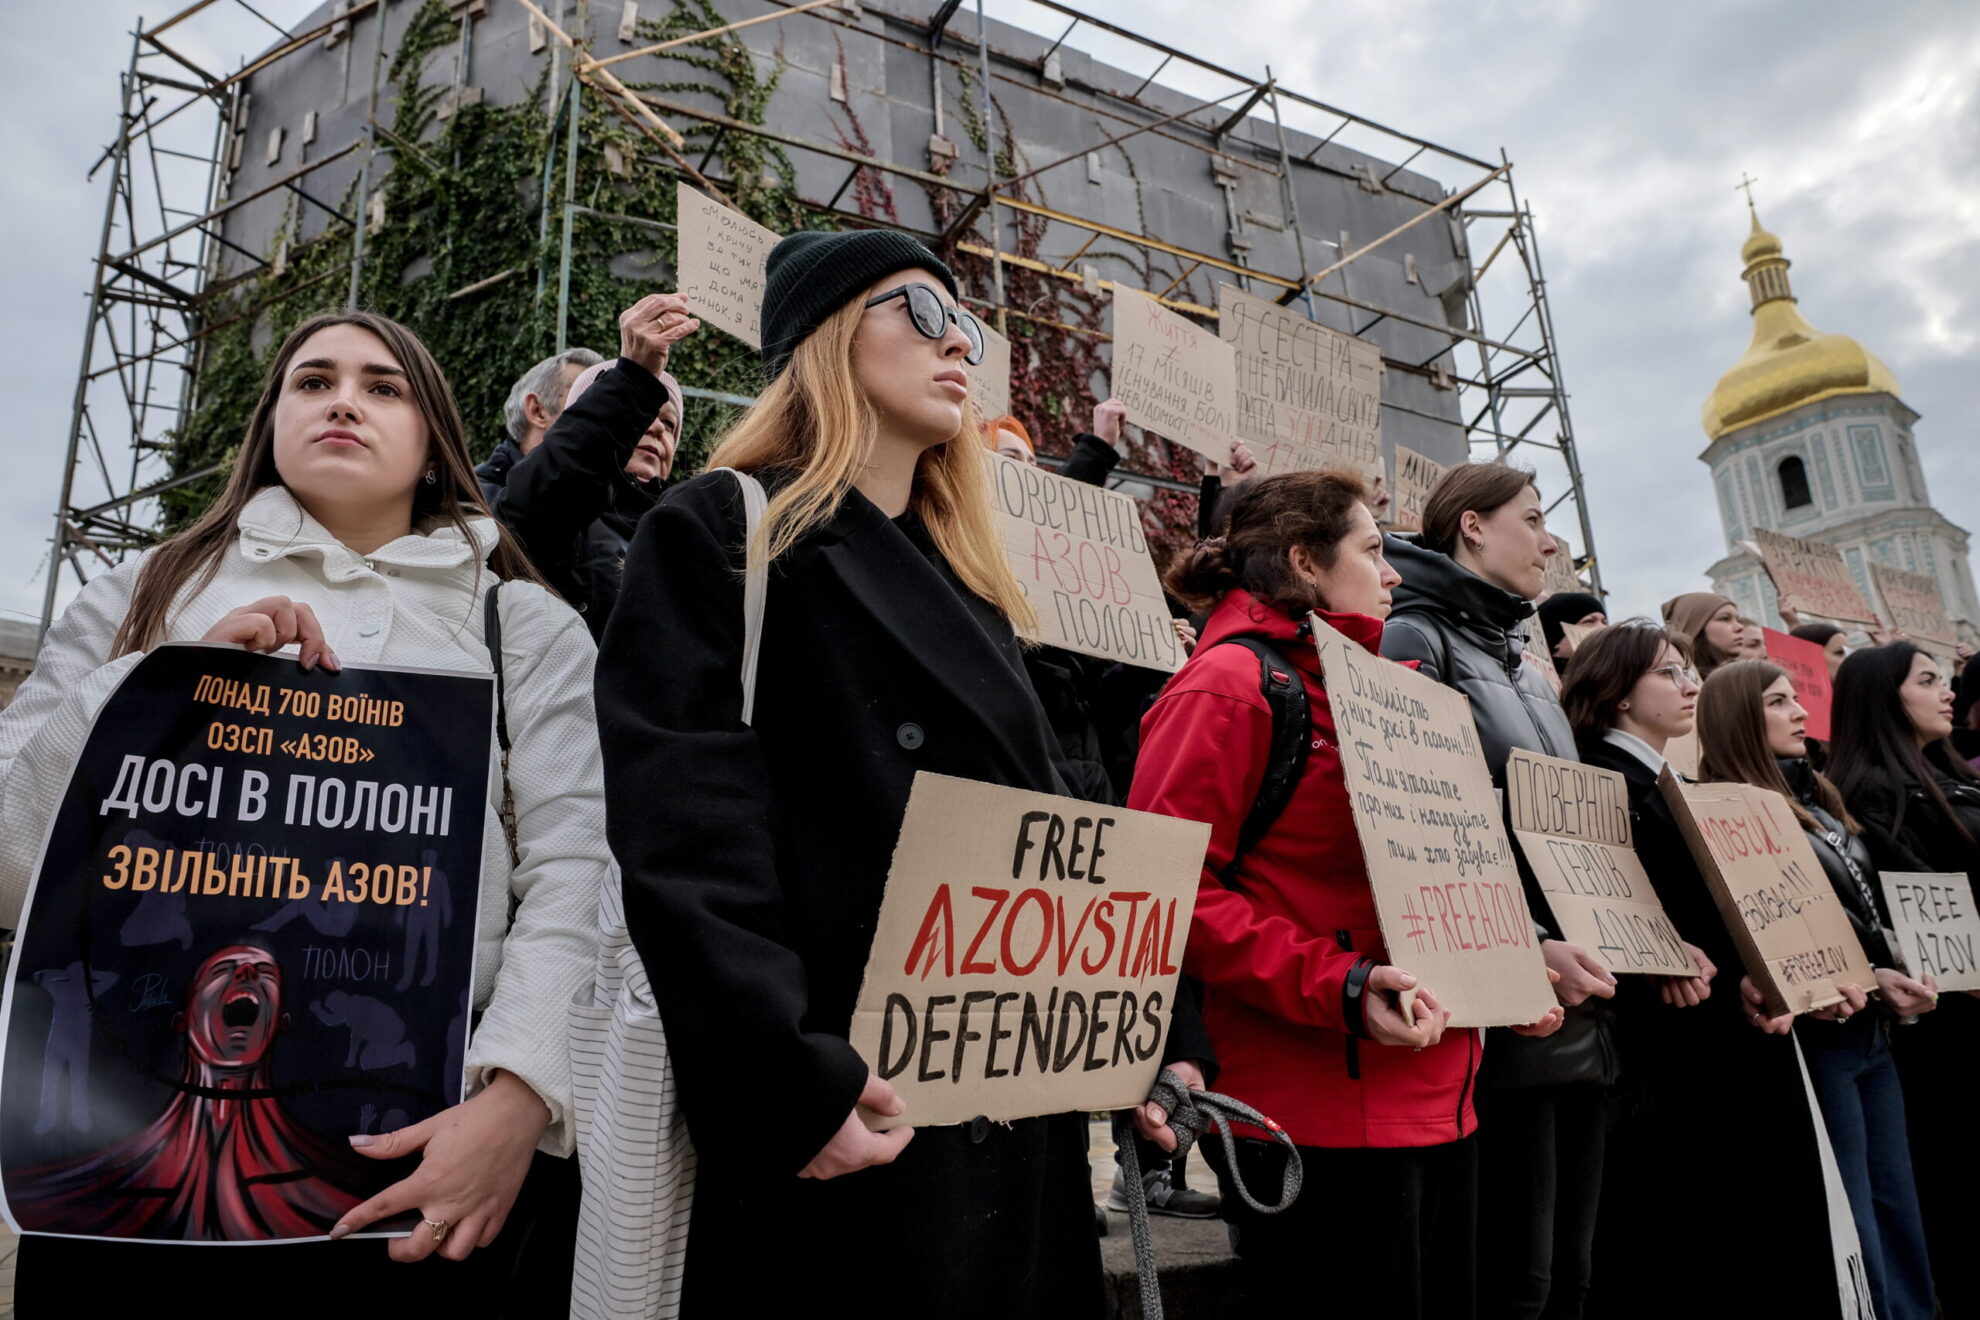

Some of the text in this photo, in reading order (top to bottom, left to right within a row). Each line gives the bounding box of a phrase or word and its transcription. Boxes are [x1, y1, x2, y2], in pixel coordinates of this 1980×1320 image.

[1257, 311, 1353, 382] СЕСТРА
[1236, 390, 1277, 439] РАТА
[1031, 527, 1132, 606] АЗОВ
[1053, 590, 1177, 667] ПОЛОНУ
[194, 674, 405, 727] ПОНАД 700 ВОЇНІВ
[207, 721, 375, 764] ОЗСП «АЗОВ»
[99, 754, 453, 836] ДОСІ В ПОЛОНІ
[1514, 757, 1628, 845] ПОВЕРНІТЬ
[102, 844, 433, 907] ЗВІЛЬНІТЬ АЗОВ!
[1012, 810, 1117, 885] FREE
[904, 882, 1179, 987] AZOVSTAL
[1401, 881, 1531, 953] #FREEAZOV
[1896, 883, 1963, 924] FREE
[303, 944, 390, 981] ПОЛОН
[1778, 945, 1850, 986] #FREEAZOV
[1914, 931, 1978, 976] AZOV
[877, 986, 1164, 1084] DEFENDERS
